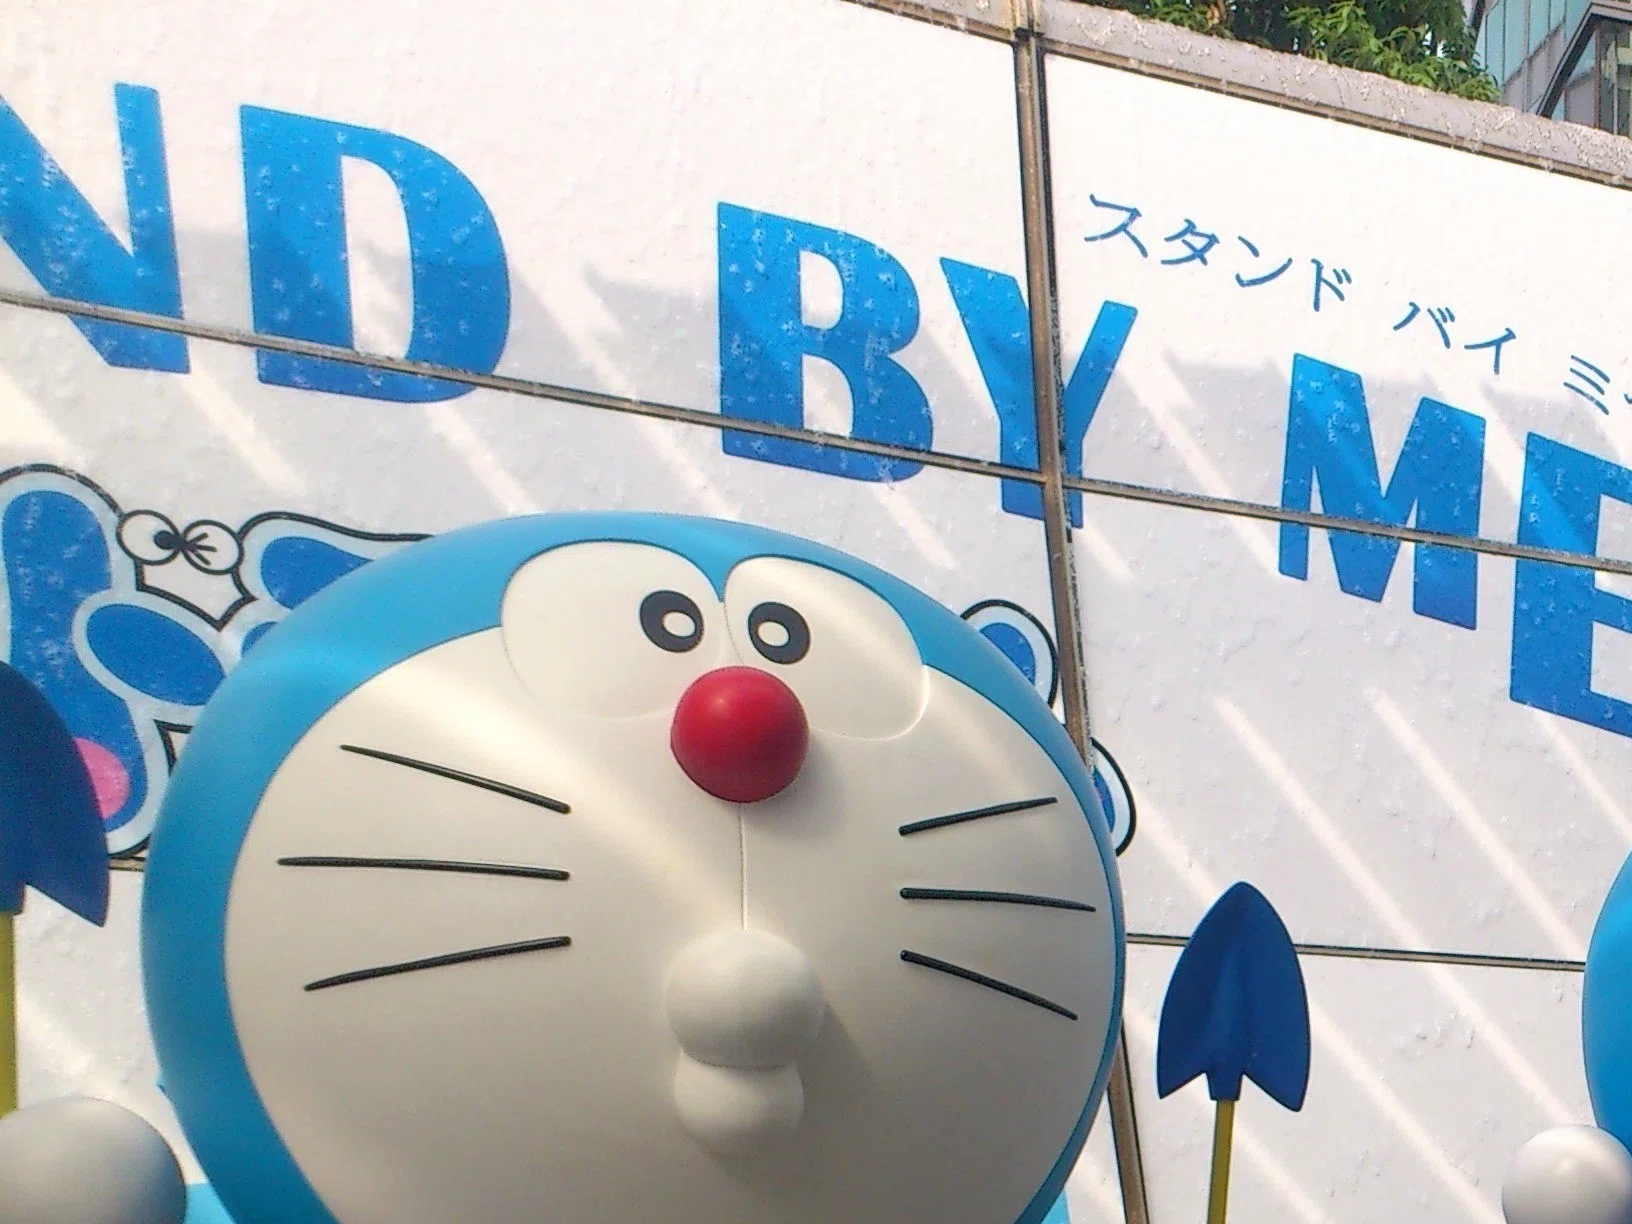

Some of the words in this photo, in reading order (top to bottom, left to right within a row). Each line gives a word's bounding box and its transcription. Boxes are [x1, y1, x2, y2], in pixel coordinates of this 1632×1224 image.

[717, 201, 1138, 529] BY
[1084, 193, 1352, 312] スタンド
[1393, 301, 1517, 375] バイ
